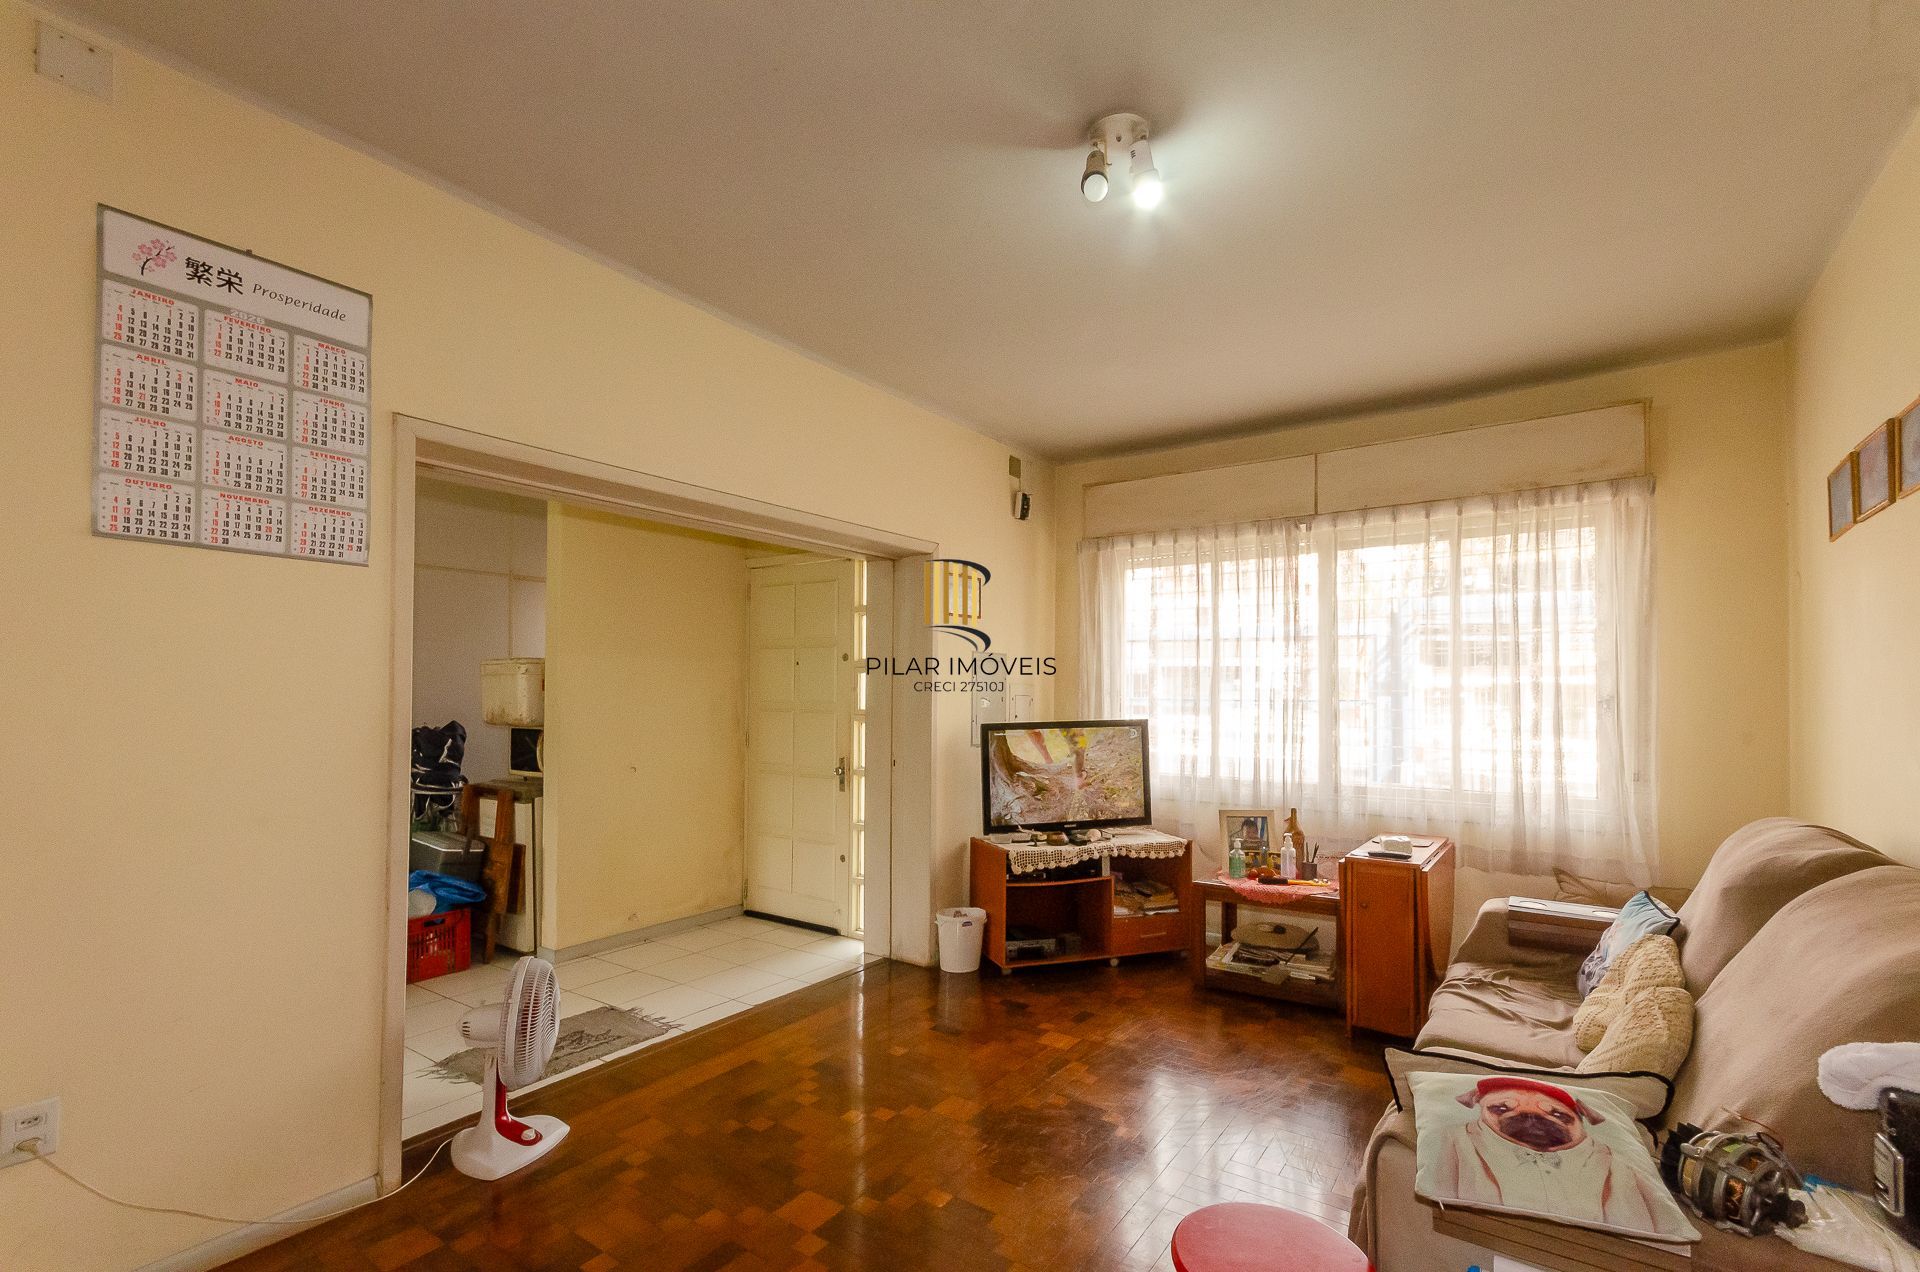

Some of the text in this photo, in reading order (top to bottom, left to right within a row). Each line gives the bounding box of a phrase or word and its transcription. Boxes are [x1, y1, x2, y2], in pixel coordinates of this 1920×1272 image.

[184, 257, 243, 295] 繁栄
[252, 283, 346, 322] Prosperidade
[224, 316, 272, 333] FEVEREIRO
[136, 354, 166, 365] ABRIL
[235, 378, 258, 388] MAIO
[134, 417, 166, 427] JULHO
[228, 435, 264, 446] AGOSTO
[112, 441, 120, 449] 12
[150, 448, 157, 456] 15
[174, 452, 180, 460] 17
[310, 451, 352, 462] SETEMBRO
[124, 462, 132, 470] 27
[148, 457, 156, 465] 22
[161, 459, 168, 467] 23
[172, 461, 180, 469] 24
[184, 463, 192, 471] 25
[125, 478, 172, 490] OUTUBRO
[220, 493, 269, 504] NOVEMBRO
[124, 507, 131, 515] 12
[148, 510, 155, 518] 14
[309, 506, 351, 517] DEZEMBRO
[110, 524, 118, 532] 25
[148, 519, 155, 527] 21
[159, 521, 167, 529] 22
[171, 522, 179, 530] 23
